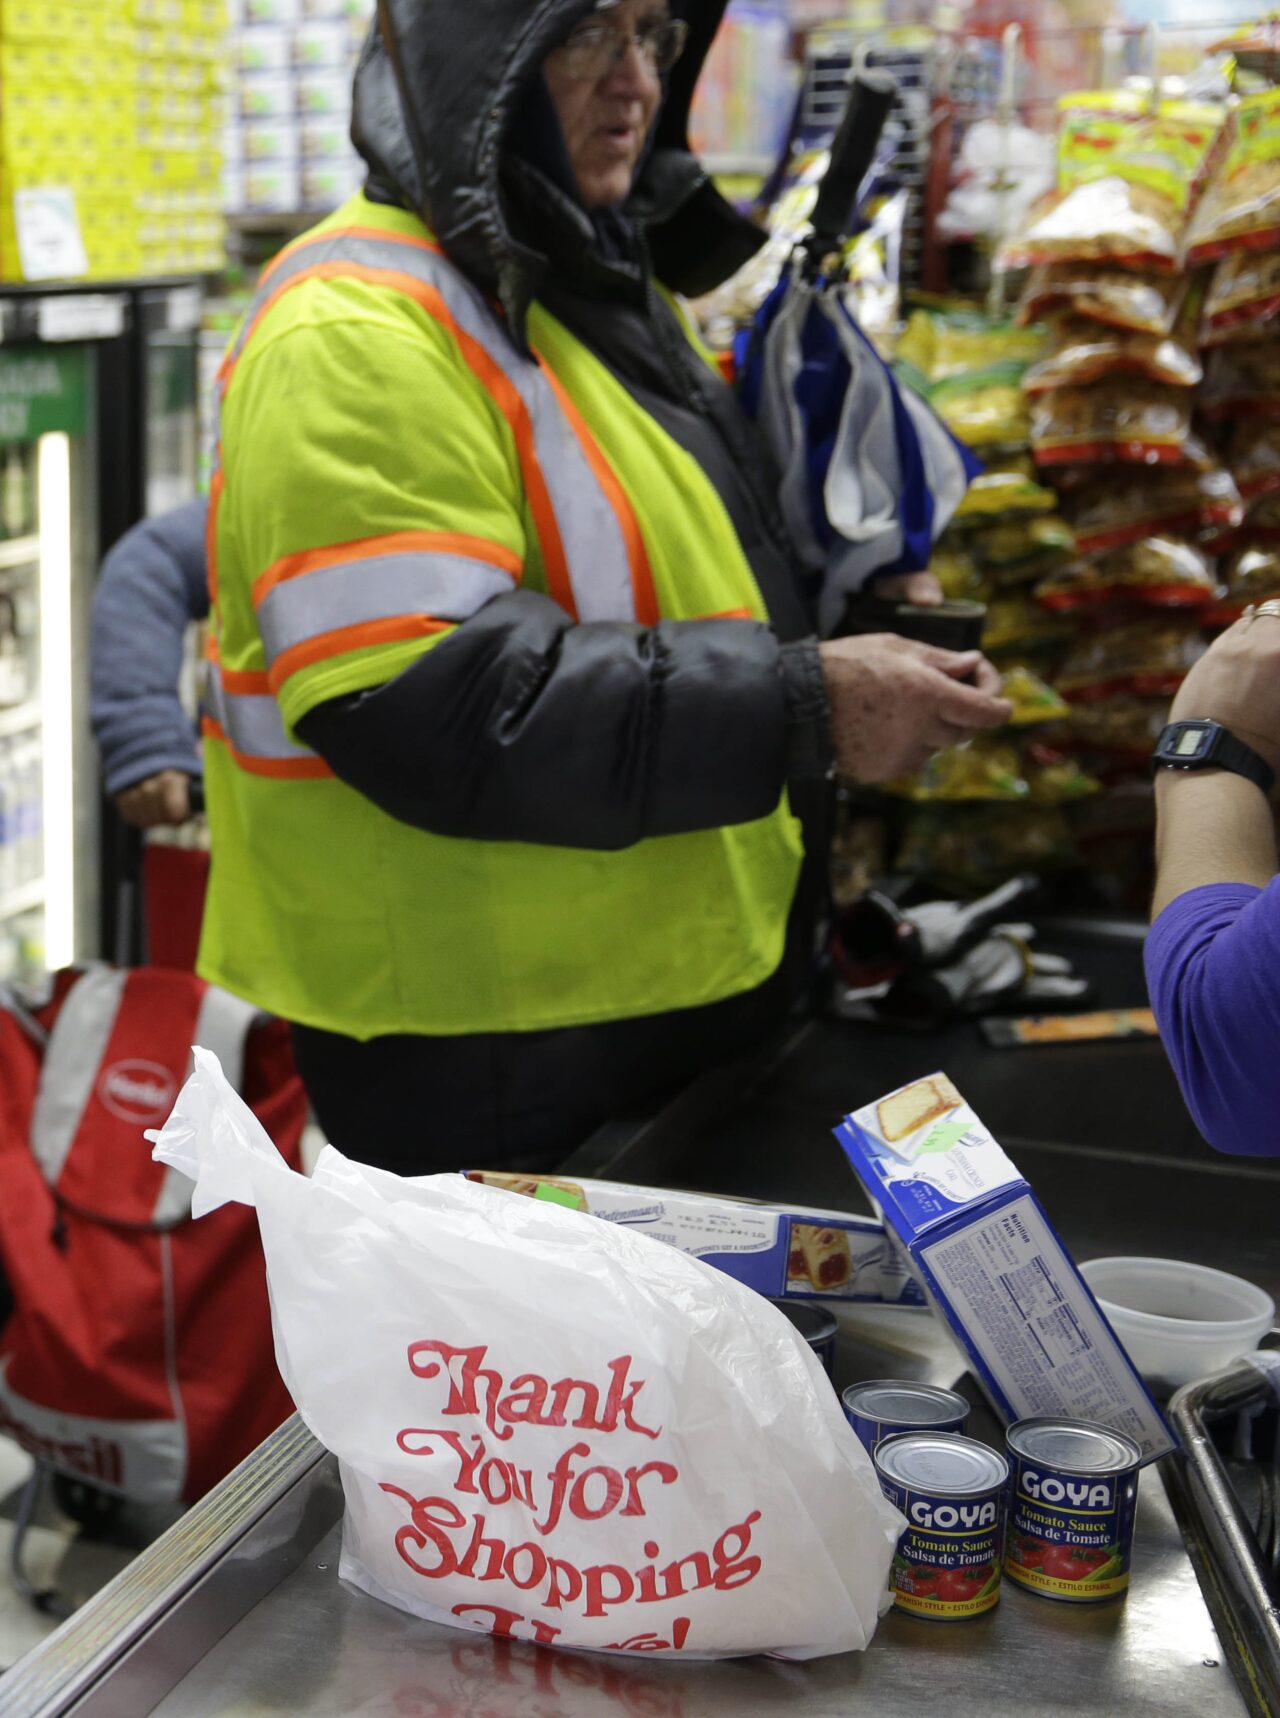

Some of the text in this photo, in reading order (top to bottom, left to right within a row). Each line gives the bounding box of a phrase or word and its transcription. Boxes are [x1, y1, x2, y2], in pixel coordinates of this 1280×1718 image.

[1000, 1217, 1017, 1238] Facts
[1009, 1212, 1031, 1244] Nutrition
[407, 1340, 663, 1441] Thank
[396, 1428, 678, 1536] You for
[1022, 1471, 1110, 1507] GOYA
[911, 1502, 996, 1528] GOYA
[1015, 1514, 1111, 1544] Salsa de Tomate
[1021, 1504, 1106, 1532] Tomato Sauce
[378, 1483, 762, 1617] Shopping
[903, 1545, 995, 1564] Salsa de Tomate
[909, 1535, 993, 1552] Tomato Sauce
[1059, 1582, 1082, 1591] ESTILO
[953, 1603, 975, 1611] ESTILO
